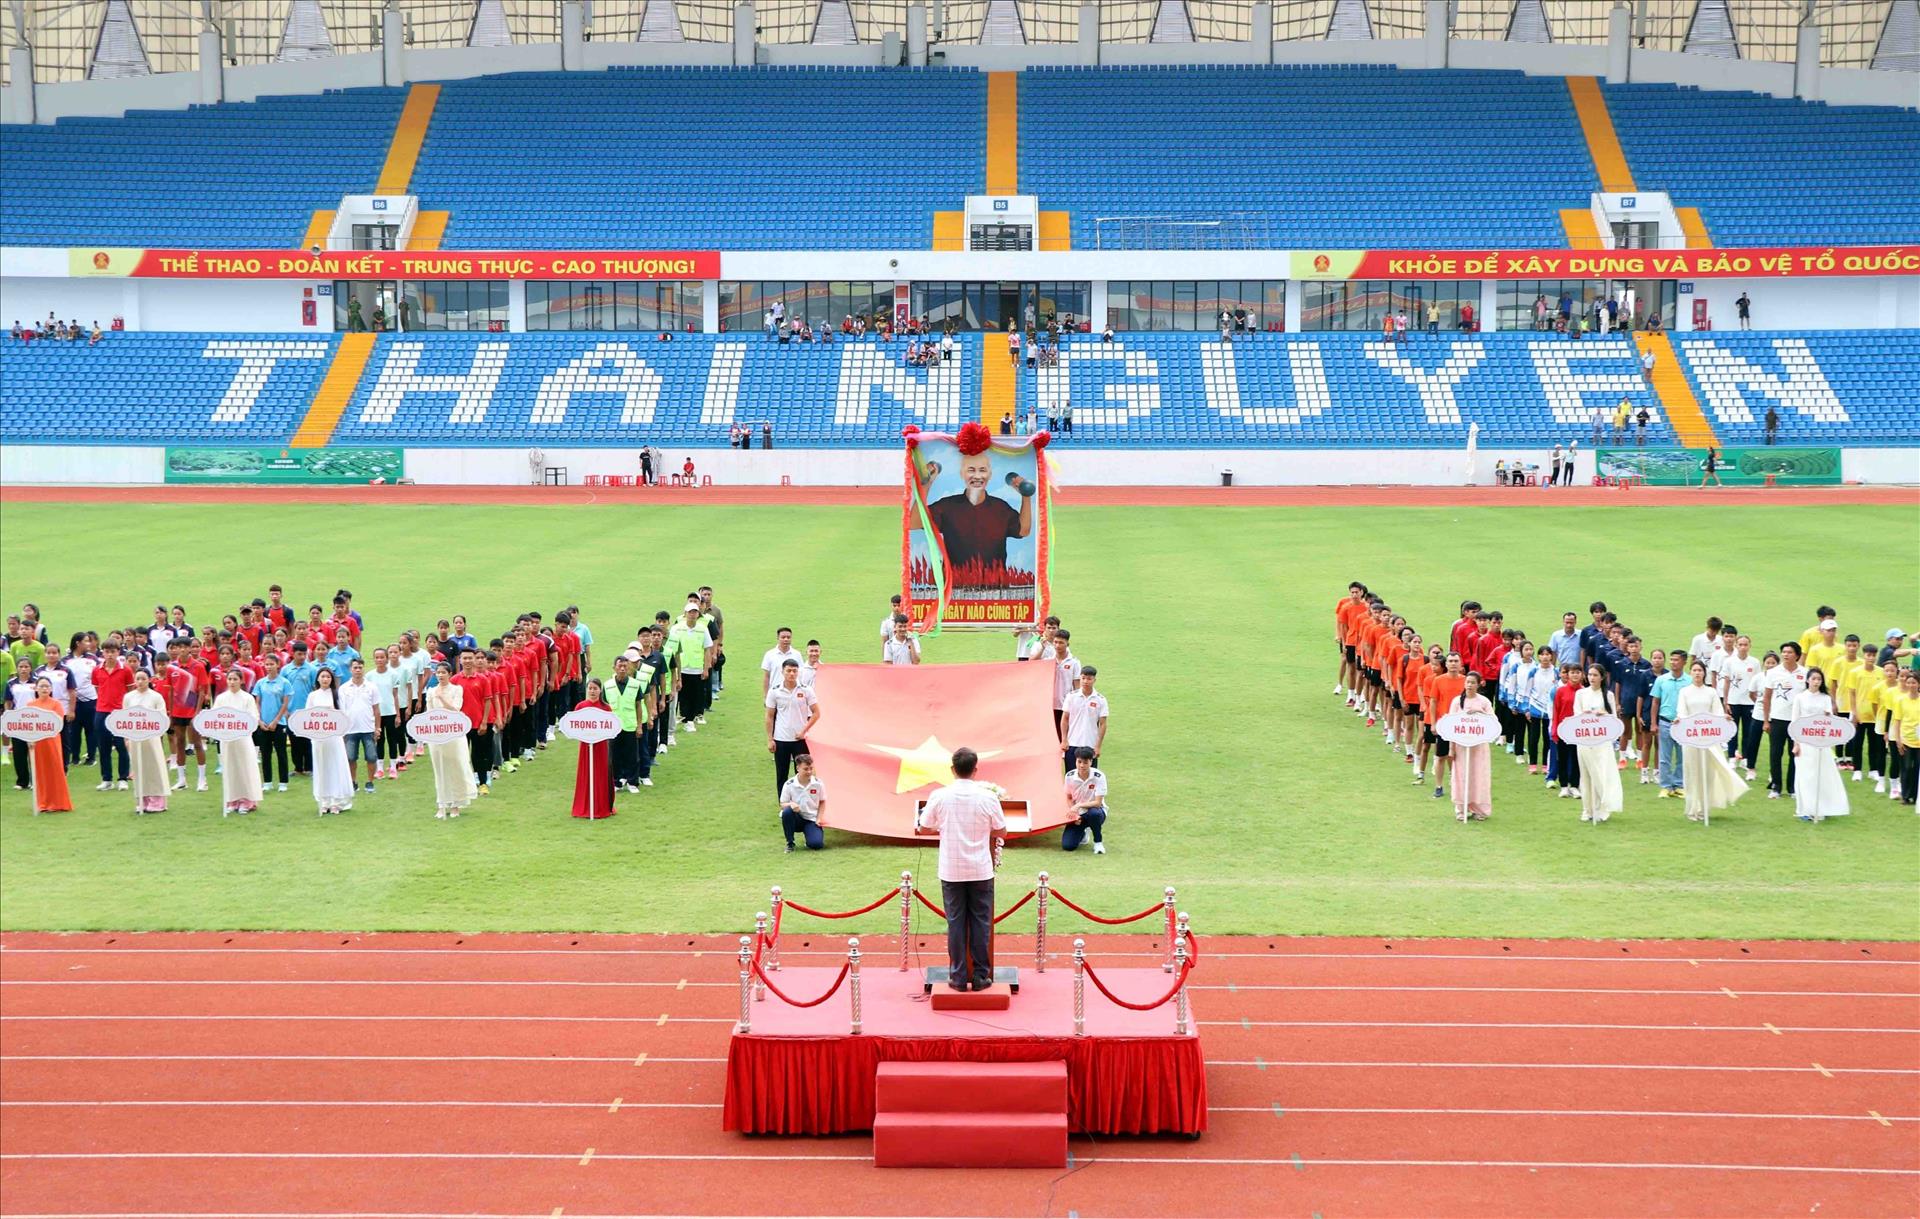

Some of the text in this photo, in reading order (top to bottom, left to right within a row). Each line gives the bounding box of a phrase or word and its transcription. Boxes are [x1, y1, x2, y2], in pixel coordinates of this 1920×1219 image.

[374, 201, 386, 209] B6
[995, 201, 1007, 209] B5
[1622, 199, 1634, 207] B7
[159, 251, 198, 274] THỂ
[203, 259, 261, 274] THAO
[278, 255, 339, 274] ĐOÀN
[346, 254, 384, 274] KẾT
[402, 259, 472, 274] TRUNG
[478, 258, 534, 278] THỰC
[552, 260, 596, 274] CAO
[602, 258, 696, 278] THƯỢNG!
[1389, 249, 1920, 277] KHỎE ĐỂ XÂY DỰNG VÀ BẢO VỆ TỔ QUỐC
[1681, 284, 1693, 292] B1
[966, 602, 985, 620] NÀO
[987, 602, 1010, 620] CŨNG
[1012, 602, 1031, 623] TẬP
[116, 720, 134, 730] CAO
[322, 721, 337, 731] CAI
[1575, 727, 1608, 738] GIA LAI
[1701, 727, 1721, 737] MAU
[1829, 728, 1842, 738] AN
